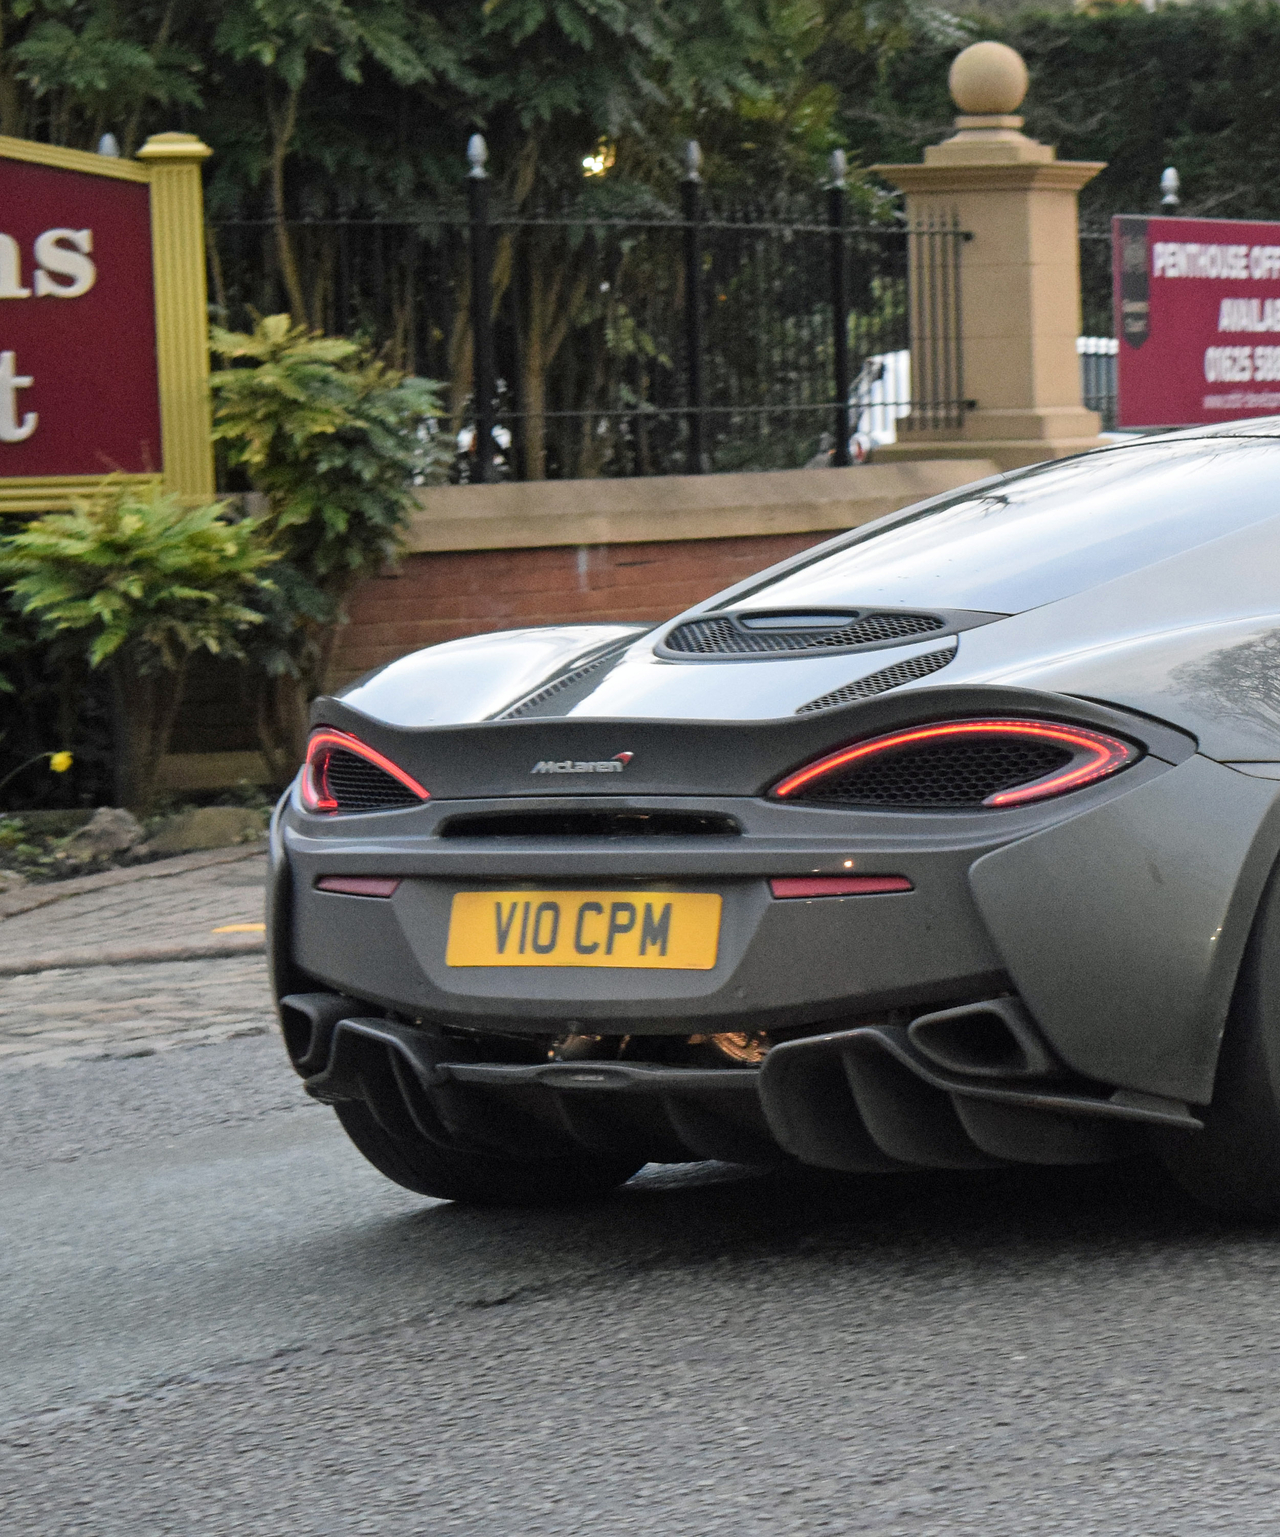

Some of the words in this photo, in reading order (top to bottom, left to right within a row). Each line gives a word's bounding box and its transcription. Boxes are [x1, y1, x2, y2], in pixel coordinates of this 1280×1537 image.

[1153, 241, 1249, 280] PENTHOUSE
[1204, 345, 1252, 383] 01625
[530, 760, 624, 774] McLaren
[495, 901, 560, 955] V10
[574, 901, 673, 957] CPM
